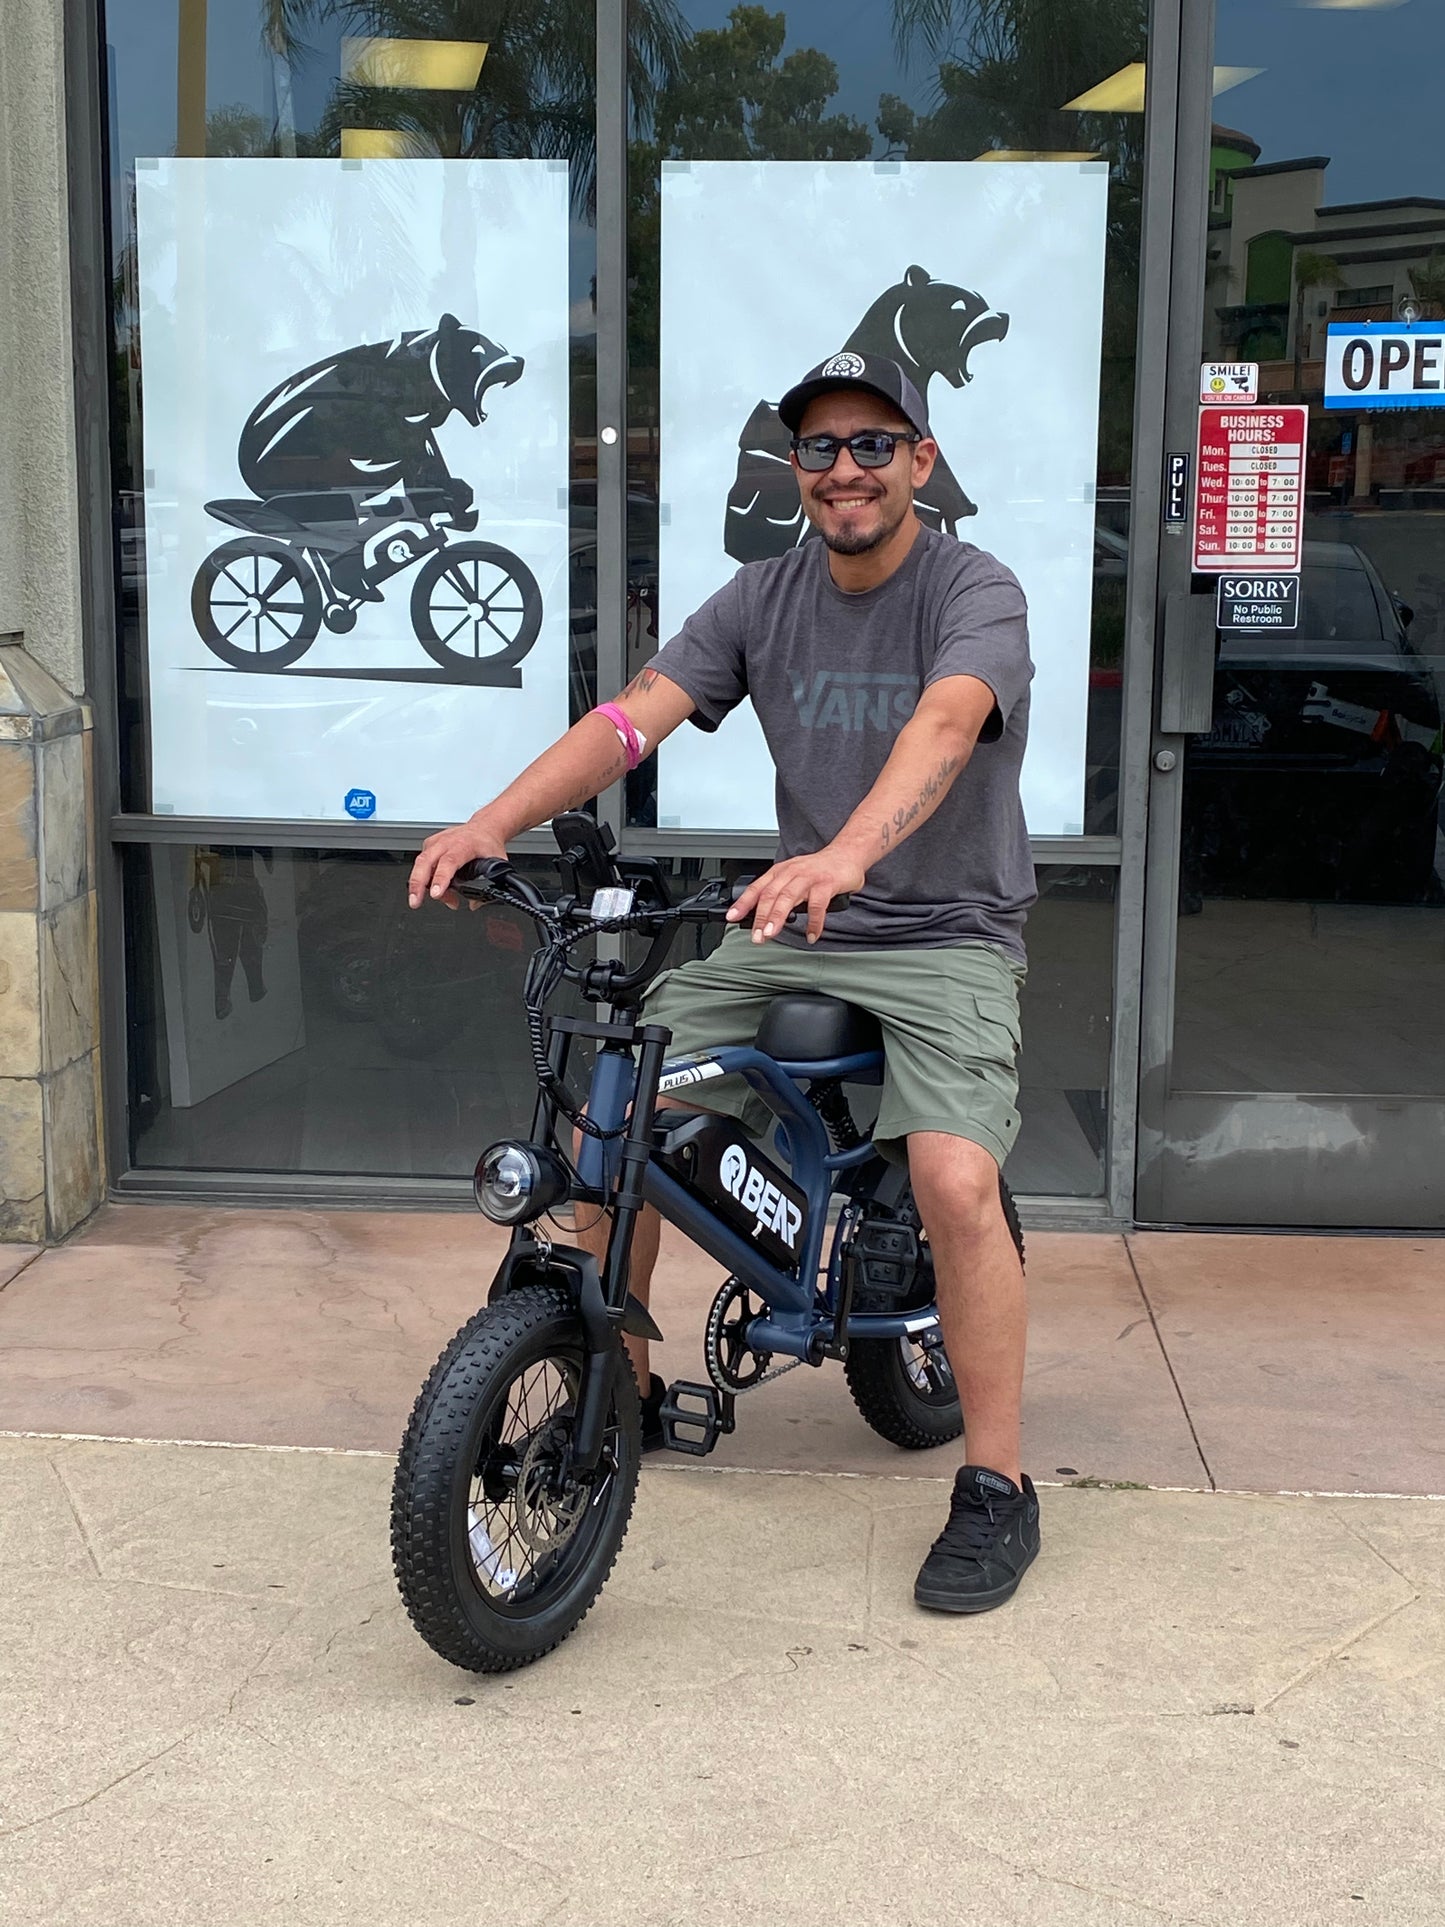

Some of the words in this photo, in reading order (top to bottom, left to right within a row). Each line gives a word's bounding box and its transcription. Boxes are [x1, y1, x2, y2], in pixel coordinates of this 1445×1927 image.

[1342, 338, 1445, 391] OPE
[1209, 366, 1251, 376] SMILE!
[1220, 415, 1284, 428] BUSINESS
[1227, 429, 1276, 442] HOURS:
[1202, 445, 1227, 456] Mon.
[1251, 446, 1278, 454] CLOSED
[1202, 461, 1227, 472] Tues.
[1250, 462, 1277, 470] CLOSED
[1171, 457, 1184, 517] PULL
[1201, 477, 1225, 488] Wed.
[1259, 478, 1267, 486] to
[1200, 493, 1225, 503] Thur.
[1259, 494, 1267, 502] to
[1200, 509, 1216, 519] Fri.
[1258, 510, 1266, 518] to
[1199, 525, 1218, 535] Sat.
[1257, 525, 1265, 534] to
[1198, 540, 1220, 551] Sun.
[1257, 541, 1265, 549] to
[1224, 580, 1294, 598] SORRY
[1233, 604, 1248, 614] No
[1251, 604, 1282, 615] Public
[1233, 614, 1282, 624] Restroom
[786, 670, 920, 732] VANS
[350, 796, 372, 808] ADT
[664, 1074, 689, 1089] PLUS
